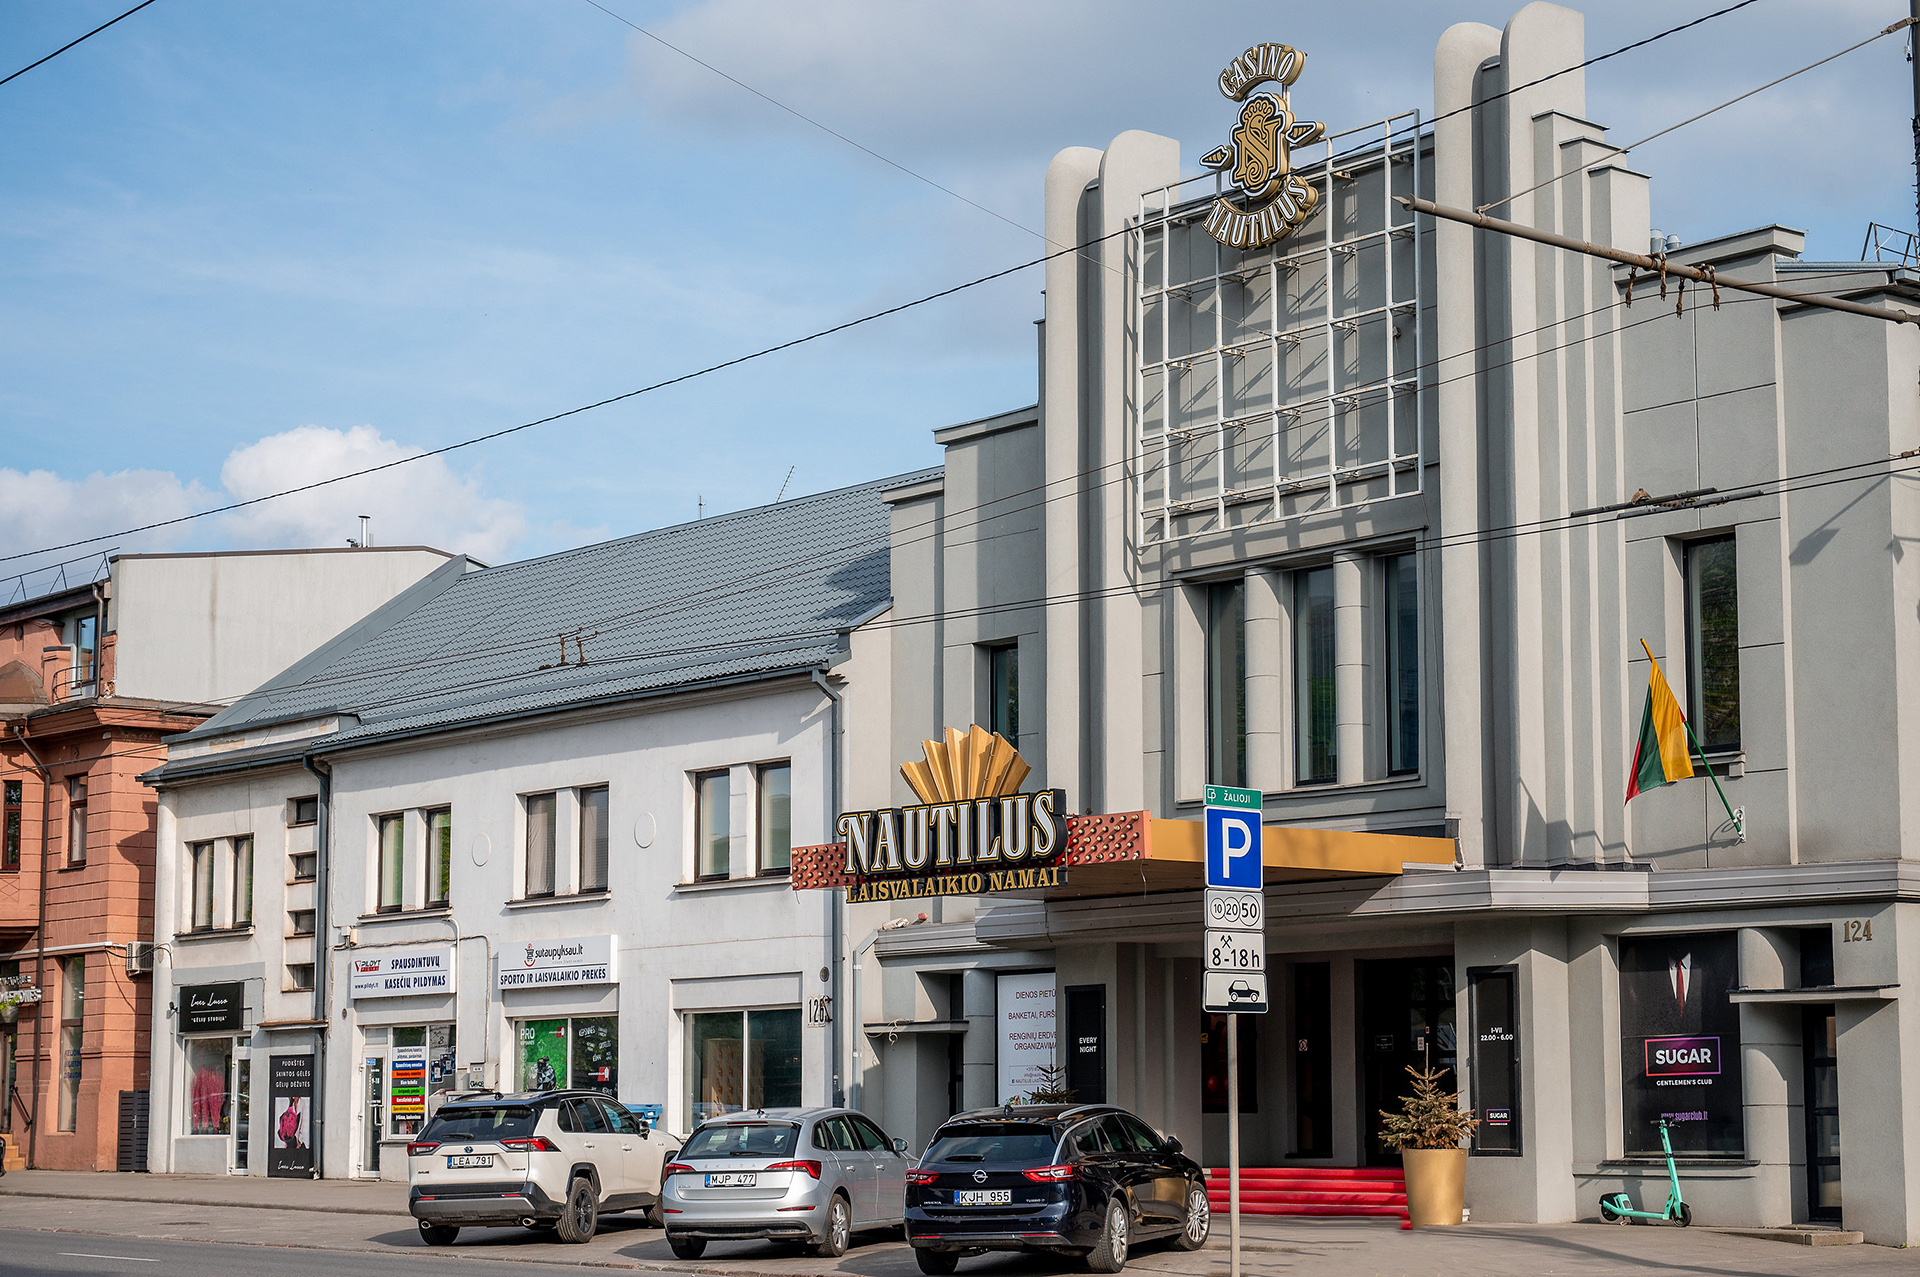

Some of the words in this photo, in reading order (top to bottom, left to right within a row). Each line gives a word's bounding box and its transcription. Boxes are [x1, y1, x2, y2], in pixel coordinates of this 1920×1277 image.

[1219, 43, 1302, 99] CASINO
[1202, 178, 1310, 247] NAUTILUS
[1223, 790, 1251, 803] ŽALIOJI
[837, 790, 1058, 874] NAUTILUS
[1221, 817, 1252, 879] P
[845, 872, 983, 904] LAISVALAIKIO
[988, 866, 1060, 892] NAMAI
[1213, 903, 1223, 914] 10
[1225, 903, 1238, 916] 20
[1241, 902, 1257, 918] 50
[1843, 919, 1873, 943] 124
[535, 943, 583, 960] sutaupyksau.lt
[391, 956, 440, 970] SPAUSDINTUVŲ
[384, 976, 411, 989] KASEČIŲ
[413, 975, 446, 987] PILDYMAS
[500, 973, 526, 986] SPORTO
[526, 973, 534, 984] IR
[535, 970, 580, 983] LAISVALAIKIO
[581, 966, 607, 980] PREKĖS
[1016, 991, 1038, 999] DIENOS
[1009, 1012, 1038, 1020] BANKETAI,
[520, 1027, 535, 1040] PRO
[1009, 1031, 1037, 1041] RENGINIŲ
[1079, 1036, 1097, 1044] EVERY
[1079, 1045, 1097, 1053] NIGHT
[1655, 1048, 1712, 1065] SUGAR
[275, 1070, 295, 1078] SKINTOS
[452, 1157, 471, 1166] LEA
[475, 1156, 491, 1165] 791
[711, 1175, 732, 1184] MJP
[737, 1174, 754, 1184] 477
[960, 1192, 984, 1202] KJH
[990, 1191, 1010, 1202] 955
